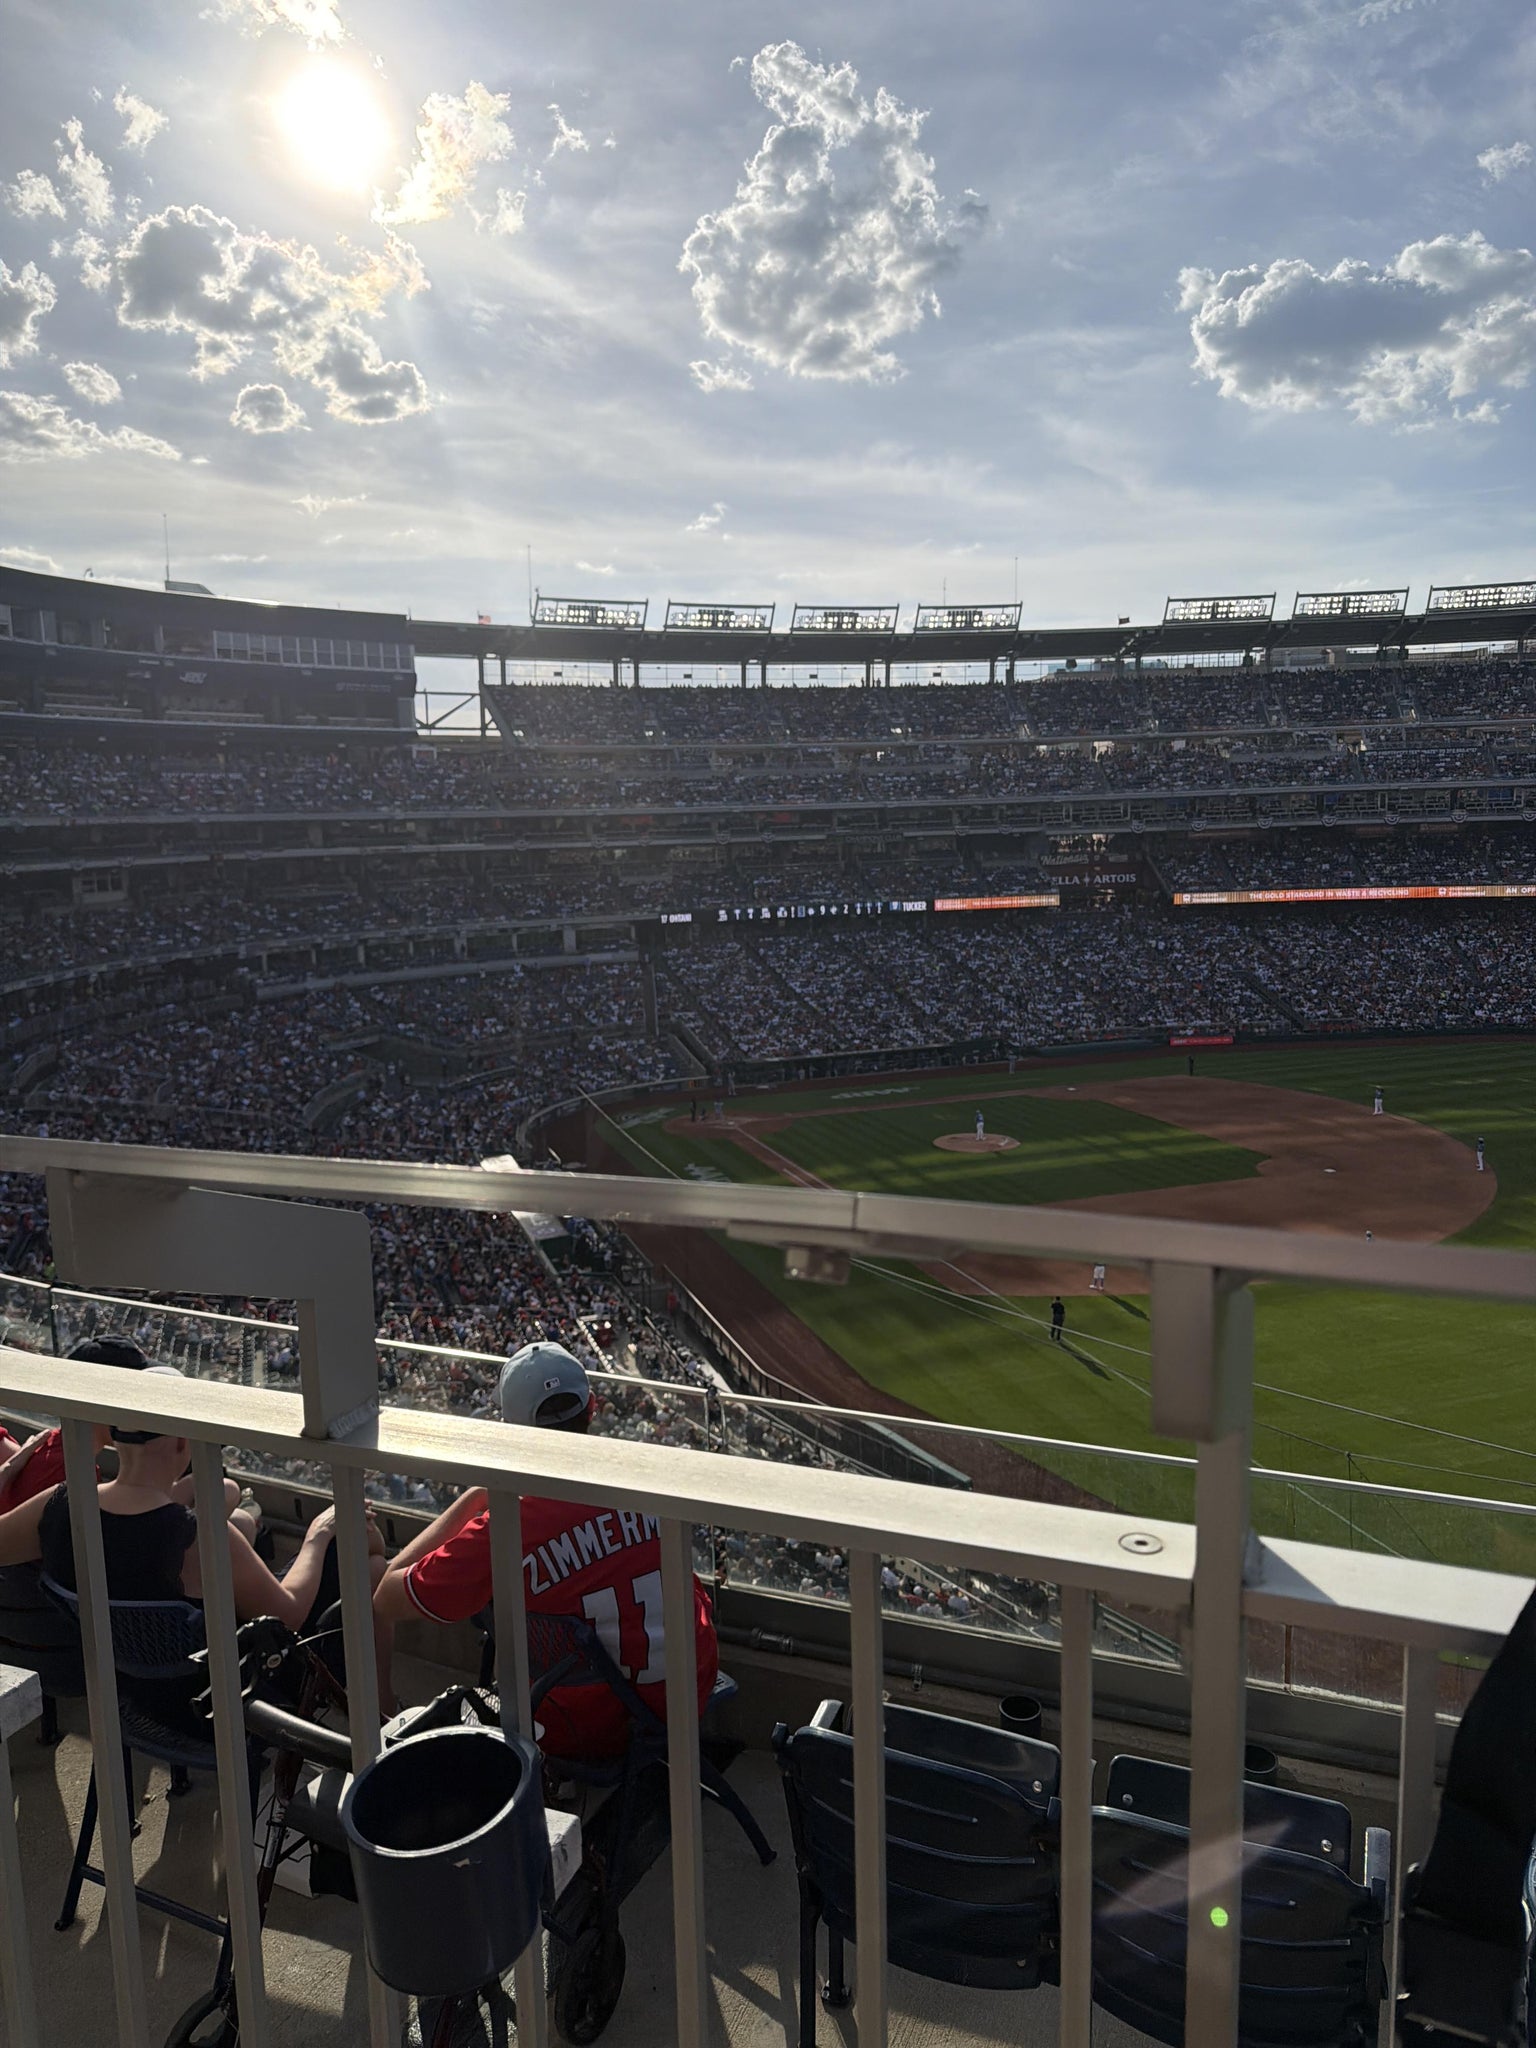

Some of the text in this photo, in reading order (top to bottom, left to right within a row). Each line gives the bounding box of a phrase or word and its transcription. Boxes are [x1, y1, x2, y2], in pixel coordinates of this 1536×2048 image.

[1093, 873, 1137, 884] ARTOIS
[902, 901, 927, 912] TUCKER
[523, 1510, 661, 1596] ZIMMERM
[582, 1570, 667, 1685] 11
